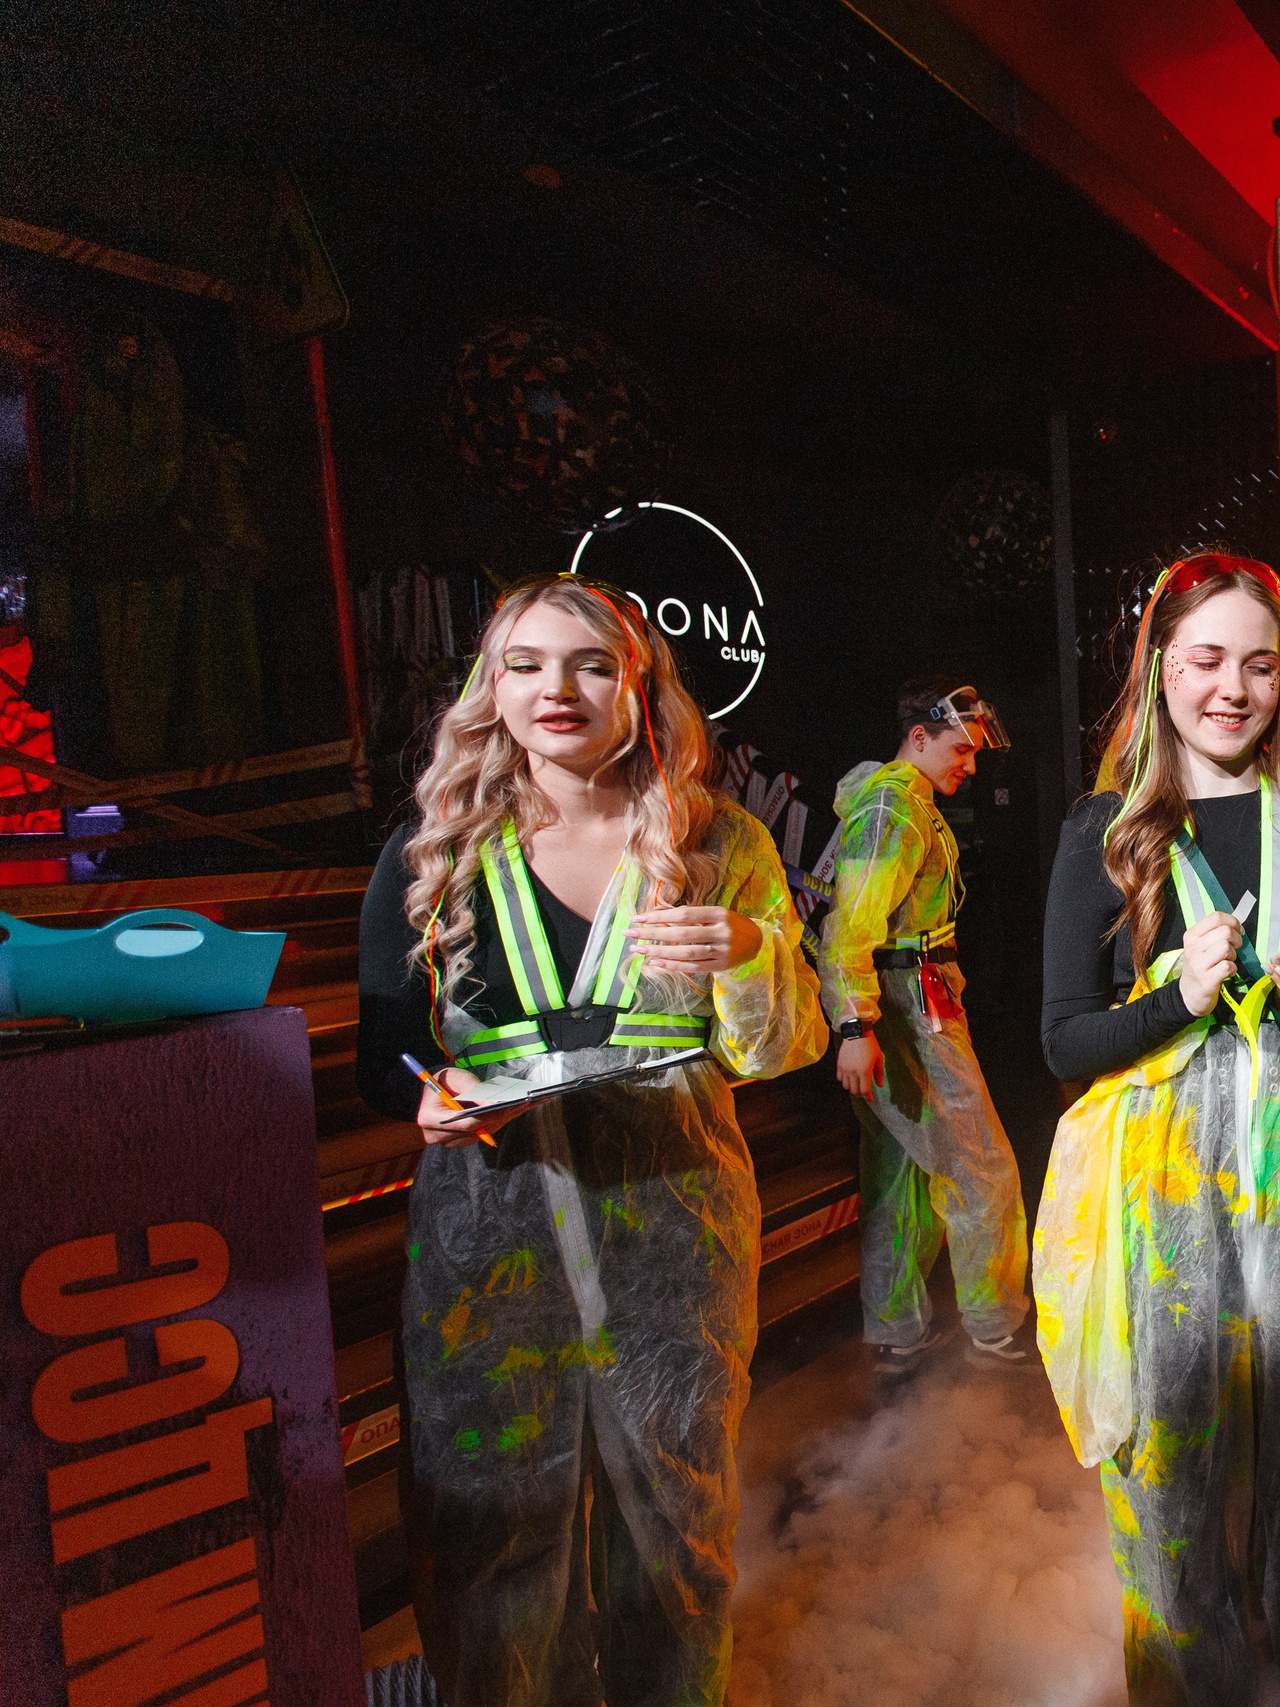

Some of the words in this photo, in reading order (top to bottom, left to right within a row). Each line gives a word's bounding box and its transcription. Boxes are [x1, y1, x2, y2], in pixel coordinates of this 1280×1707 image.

[625, 591, 766, 647] ONA
[720, 646, 760, 663] CLUB
[20, 1221, 273, 1565] ЦСС
